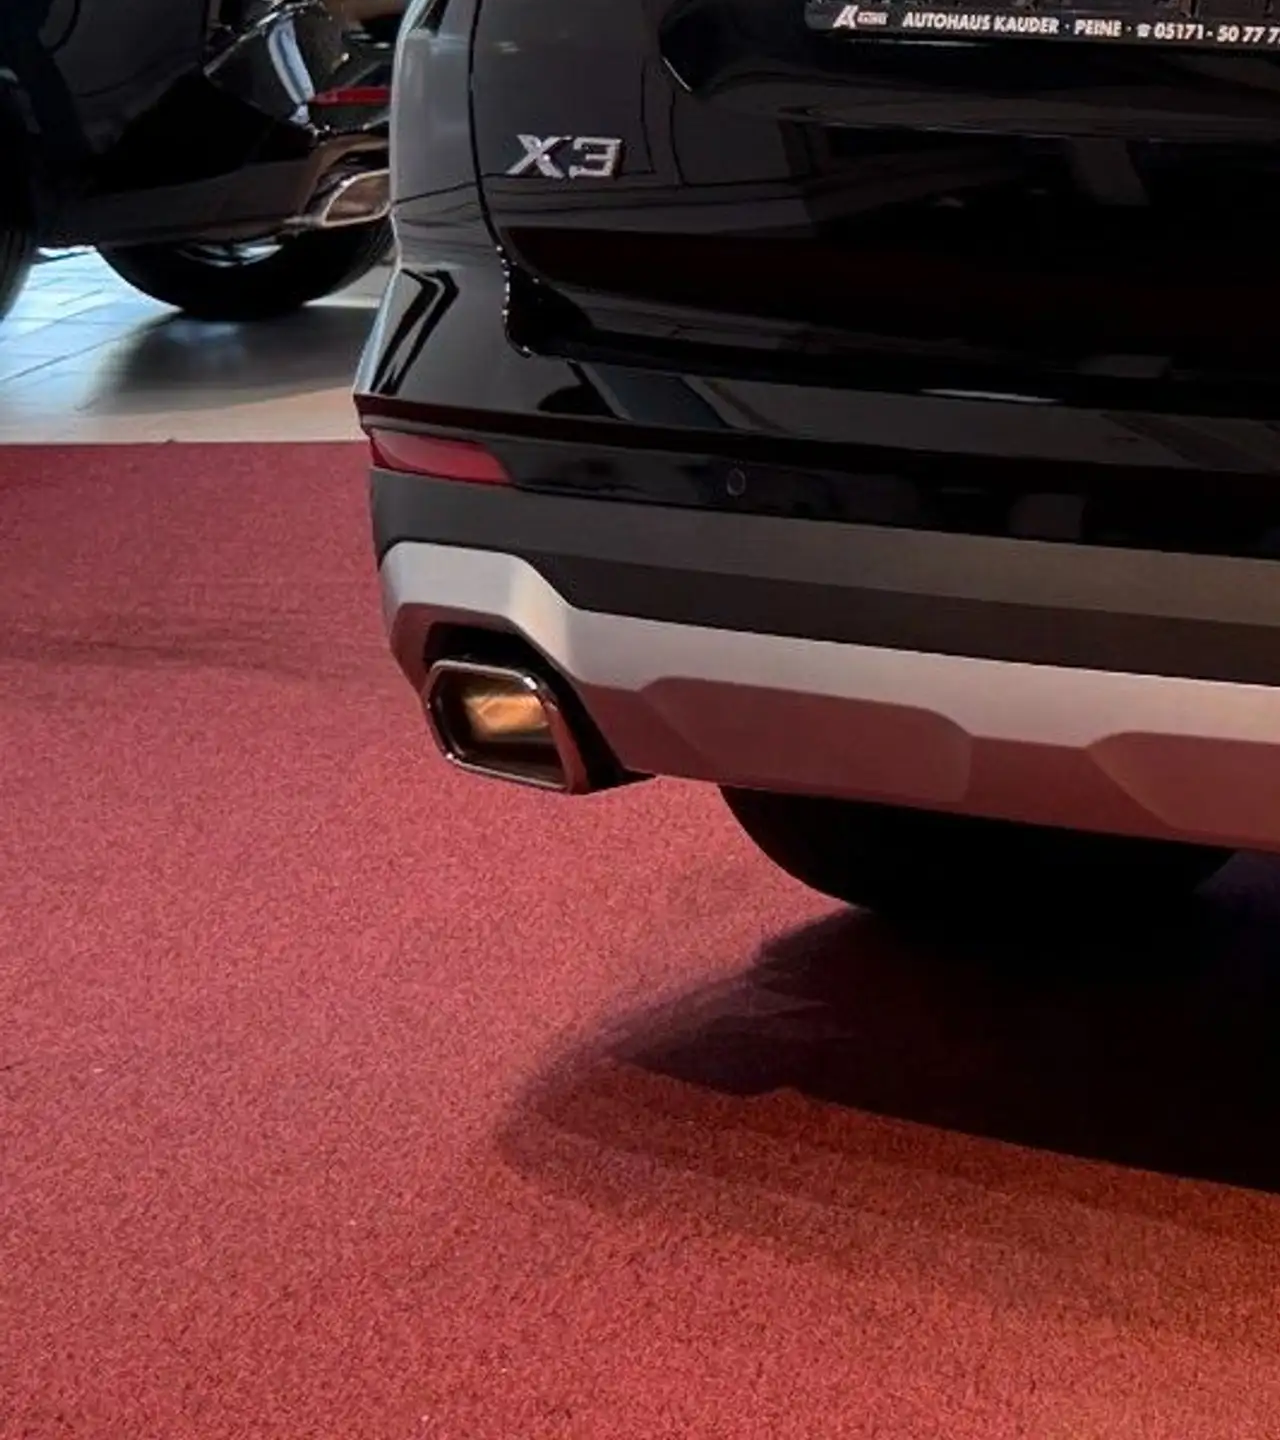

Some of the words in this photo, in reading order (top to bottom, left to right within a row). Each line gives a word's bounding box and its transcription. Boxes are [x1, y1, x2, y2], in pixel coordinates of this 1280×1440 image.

[902, 12, 991, 31] AUTOHAUS
[993, 15, 1060, 35] KAUDER
[1073, 19, 1122, 37] PEINE
[1154, 22, 1204, 40] 05171
[1216, 26, 1241, 42] 50
[1242, 27, 1264, 43] 77
[505, 133, 623, 179] X3
